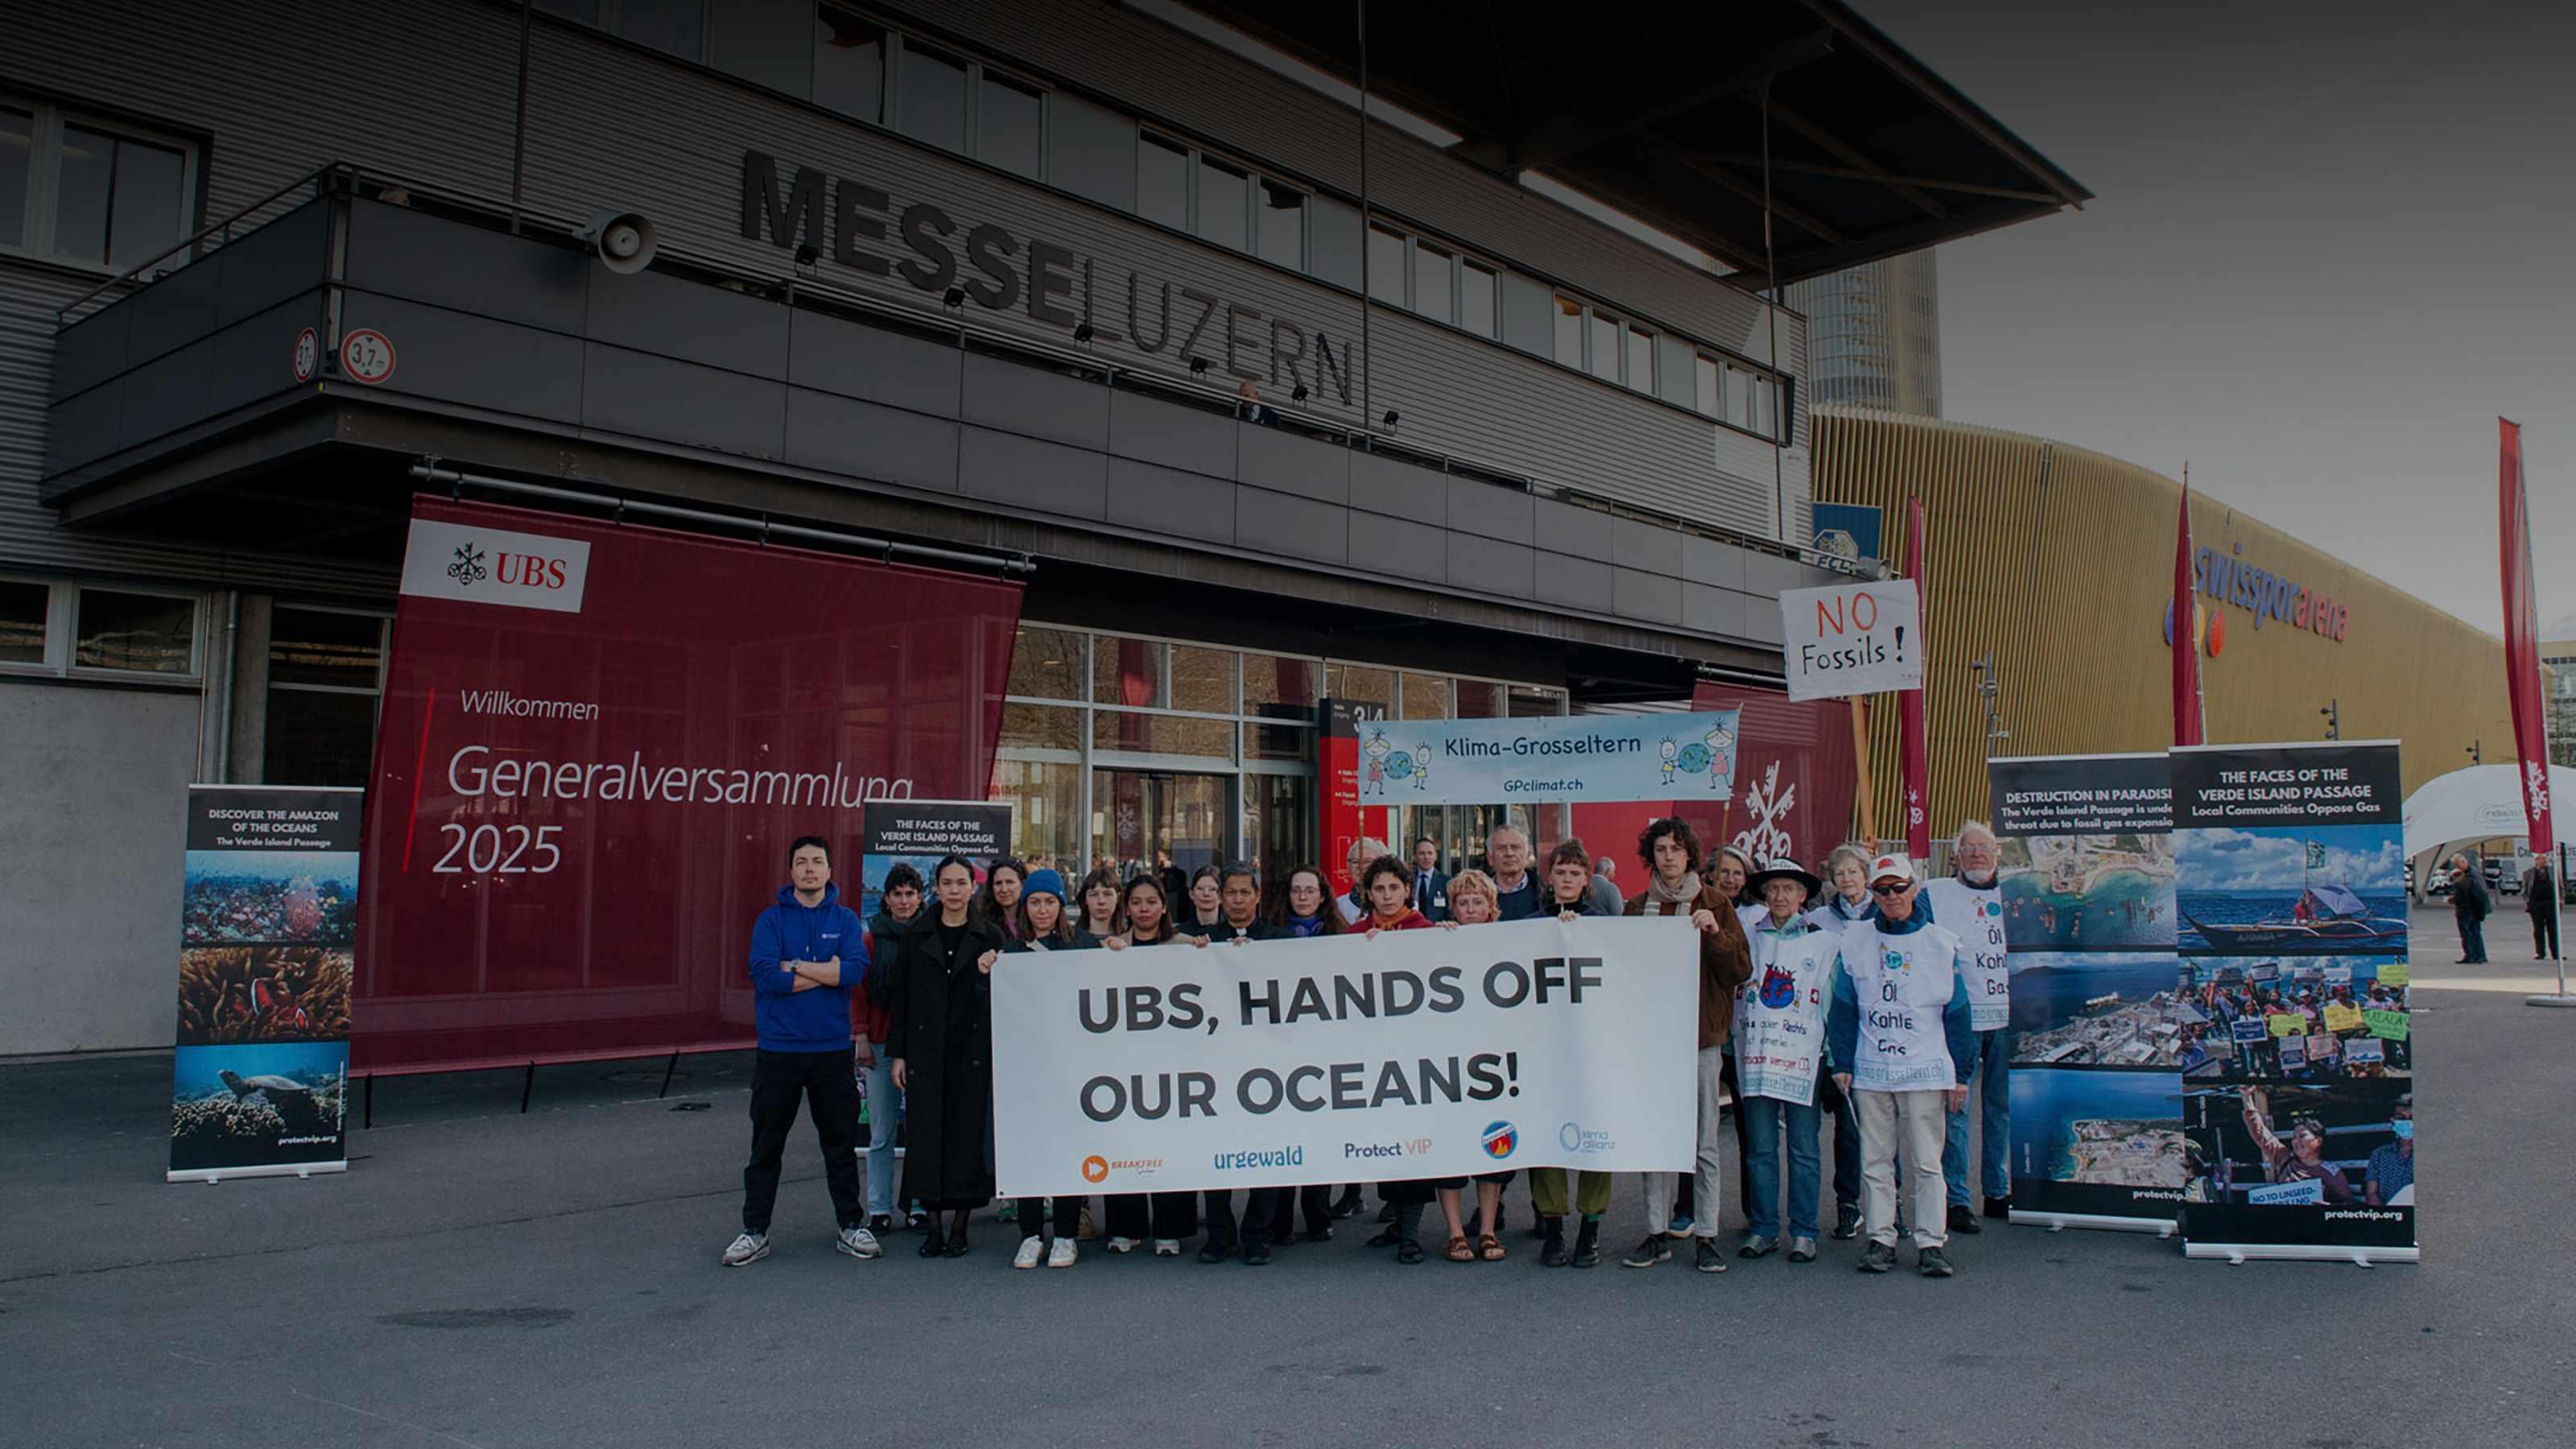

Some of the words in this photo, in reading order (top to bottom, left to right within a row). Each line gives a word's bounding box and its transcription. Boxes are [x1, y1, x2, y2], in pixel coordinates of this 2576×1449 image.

[496, 552, 567, 589] UBS
[2195, 541, 2348, 643] swissporarena
[1817, 592, 1877, 638] NO
[460, 689, 600, 720] Willkommen
[1445, 734, 1641, 757] Klima-Grosseltern
[2219, 770, 2247, 783] THE
[2249, 769, 2295, 782] FACES
[2297, 769, 2318, 782] OF
[2321, 768, 2348, 781] THE
[1504, 778, 1583, 792] GPclimat.ch
[2005, 790, 2092, 803] DESTRUCTION
[2095, 790, 2110, 802] IN
[2198, 787, 2246, 801] VERDE
[2248, 786, 2301, 800] ISLAND
[2303, 785, 2372, 799] PASSAGE
[208, 809, 265, 819] DISCOVER
[266, 810, 287, 820] THE
[288, 811, 339, 821] AMAZON
[2000, 807, 2021, 817] The
[2022, 806, 2054, 817] Verde
[2056, 805, 2087, 816] Island
[2090, 804, 2134, 816] Passage
[2136, 804, 2145, 814] is
[2192, 804, 2223, 816] Local
[2225, 803, 2305, 815] Communities
[2306, 803, 2354, 815] Oppose
[2355, 801, 2380, 812] Gas
[232, 822, 248, 832] OF
[250, 823, 270, 833] THE
[270, 823, 318, 833] OCEANS
[895, 819, 914, 829] THE
[915, 819, 947, 830] FACES
[947, 820, 961, 831] OF
[963, 821, 980, 831] THE
[2004, 820, 2037, 831] threat
[2039, 819, 2059, 829] due
[2061, 819, 2073, 829] to
[2074, 818, 2101, 828] fossil
[2103, 819, 2123, 830] gas
[217, 836, 233, 846] The
[235, 837, 262, 847] Verde
[264, 837, 292, 847] Island
[293, 838, 332, 849] Passage
[881, 831, 912, 841] VERDE
[913, 832, 948, 842] ISLAND
[949, 832, 995, 844] PASSAGE
[431, 824, 564, 874] 2025
[875, 843, 897, 851] Local
[898, 843, 950, 853] Communities
[951, 844, 982, 855] Oppose
[983, 845, 999, 854] Gas
[1988, 925, 2002, 944] Öl
[1882, 980, 1897, 1001] Öl
[1987, 978, 2009, 995] Ga
[1077, 982, 1219, 1035] UBS,
[1239, 965, 1466, 1026] HANDS
[1483, 956, 1603, 1009] OFF
[1079, 1071, 1218, 1122] OUR
[1236, 1051, 1521, 1116] OCEANS!
[1344, 1142, 1402, 1158] Protect
[1404, 1138, 1433, 1155] VIP
[1214, 1146, 1302, 1169] urgewald
[2253, 1195, 2265, 1203] NO
[2266, 1192, 2278, 1200] TO
[2324, 1208, 2403, 1221] protectvip.org
